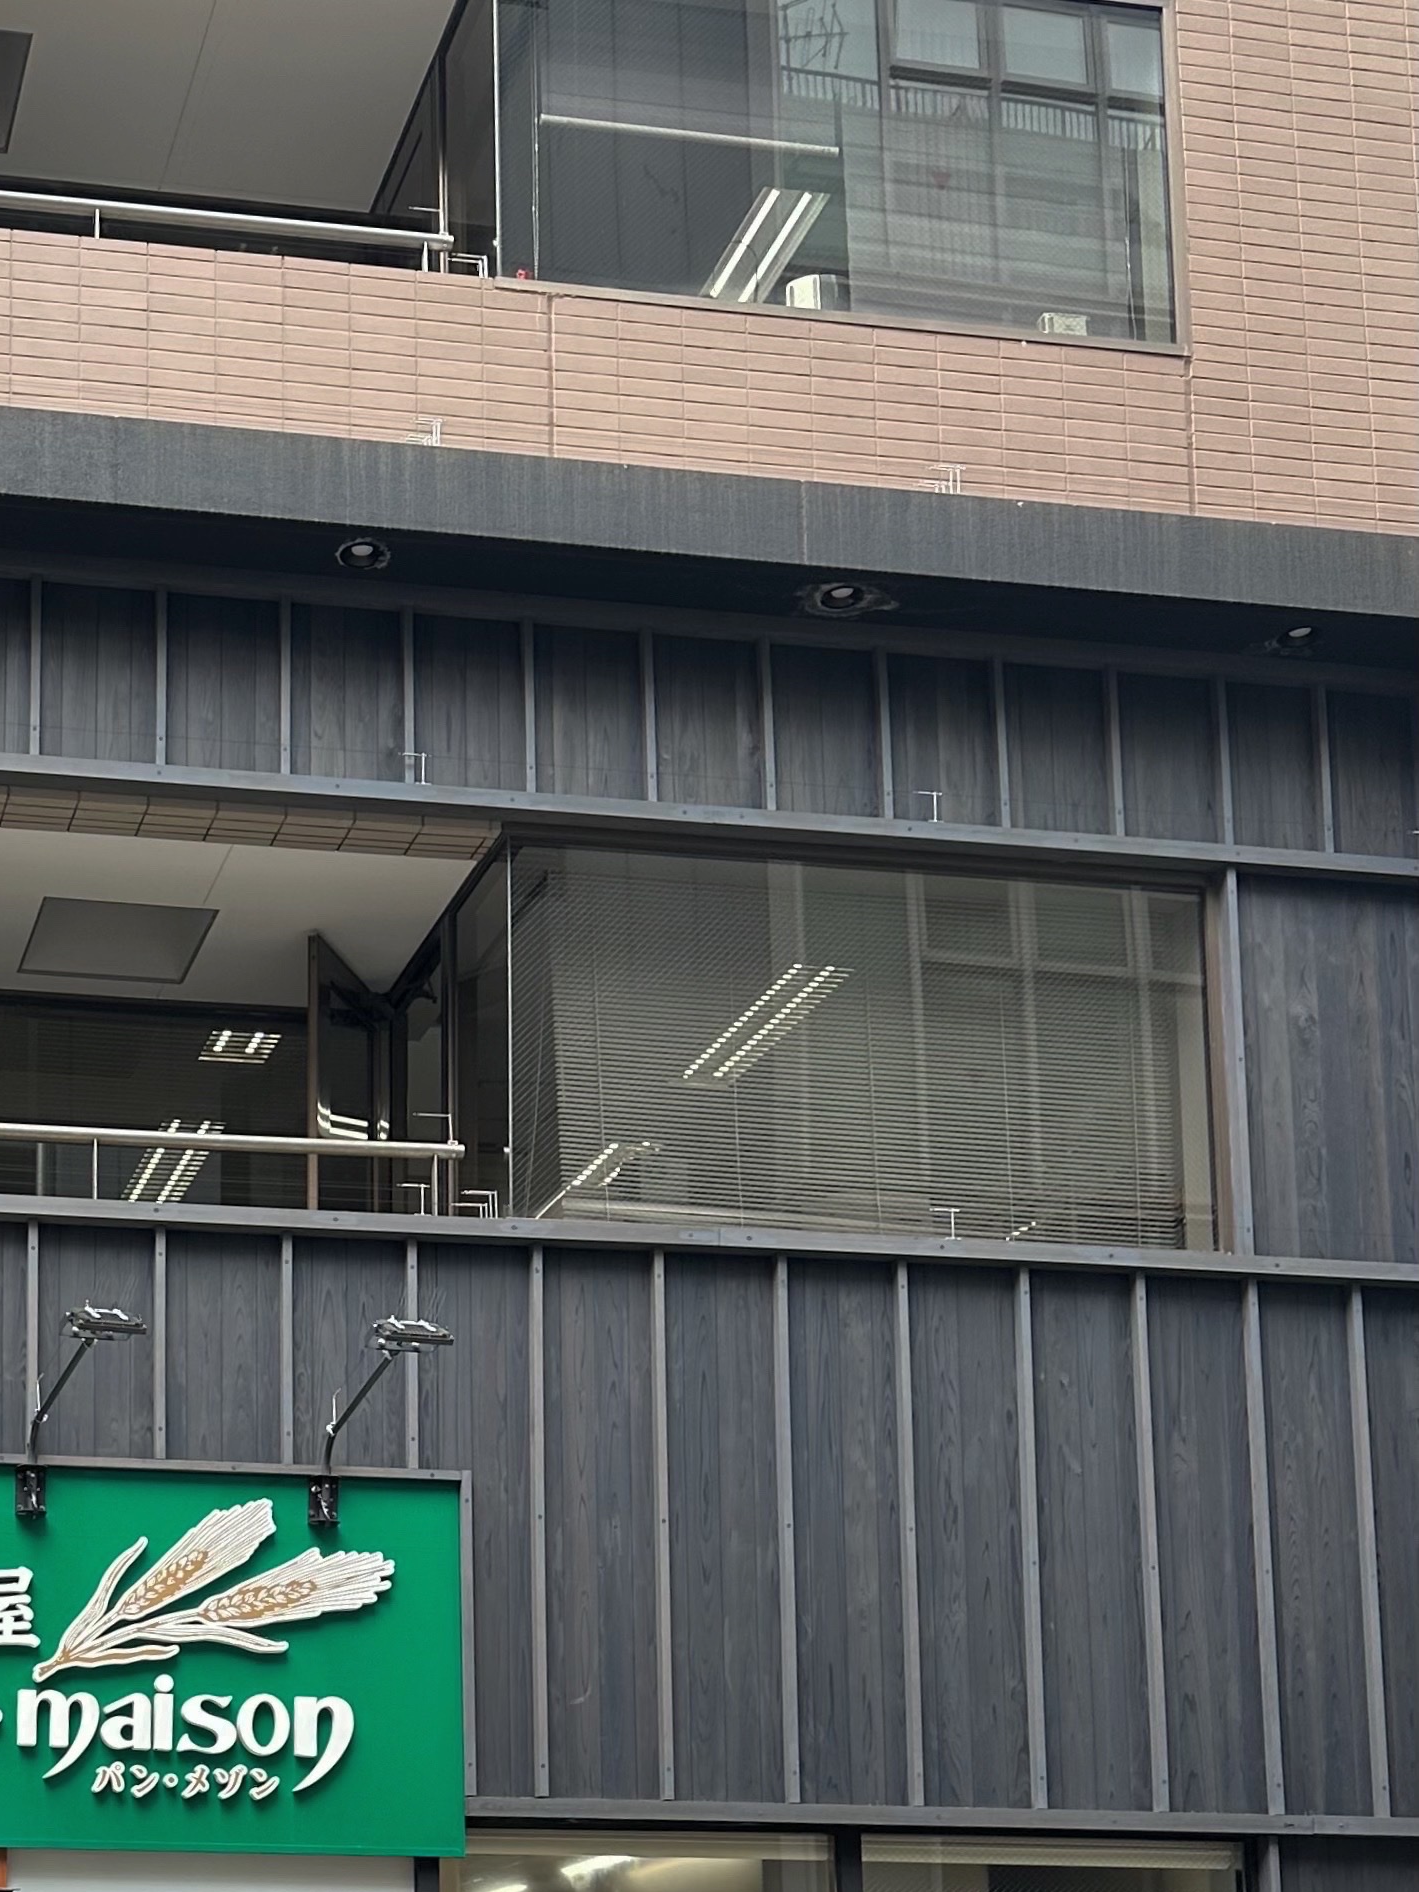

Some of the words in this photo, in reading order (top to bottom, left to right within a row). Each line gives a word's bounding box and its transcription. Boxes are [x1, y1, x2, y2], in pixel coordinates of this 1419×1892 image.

[90, 1762, 281, 1800] パン・メゾン
